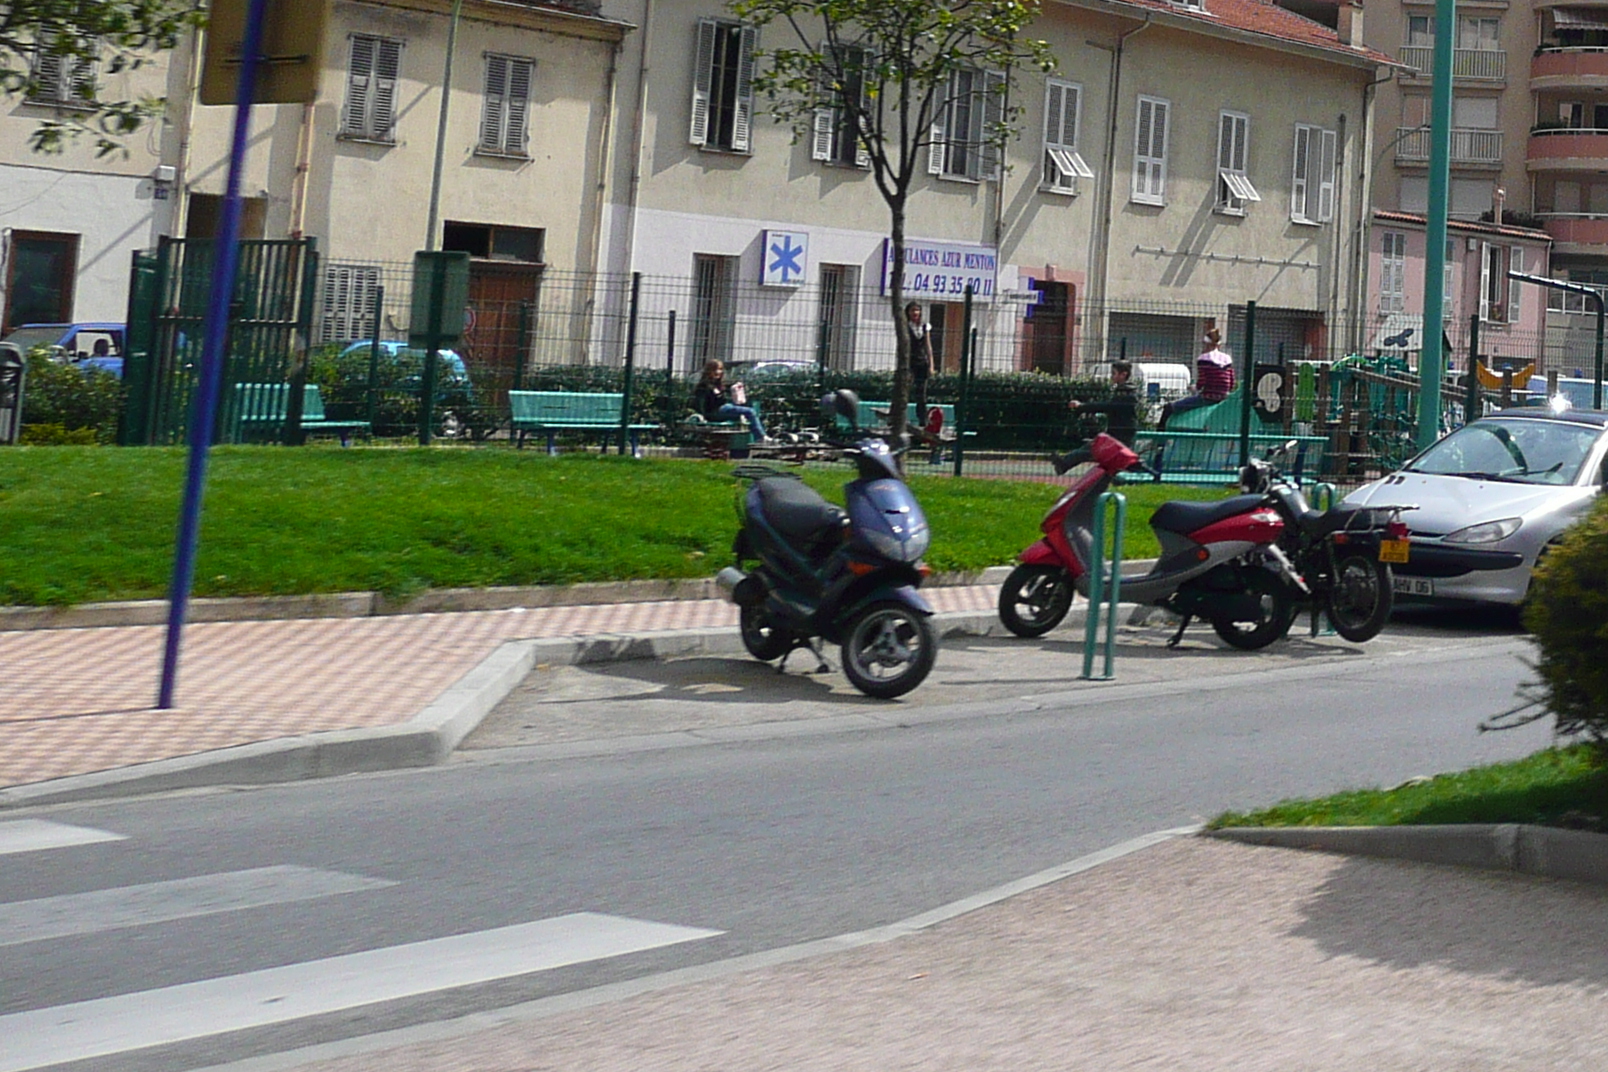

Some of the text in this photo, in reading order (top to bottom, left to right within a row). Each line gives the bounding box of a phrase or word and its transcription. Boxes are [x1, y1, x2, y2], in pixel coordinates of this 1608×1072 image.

[888, 247, 995, 270] AULANCES AZUR MENTON
[914, 273, 930, 291] 04
[933, 275, 947, 293] 93
[949, 276, 963, 294] 35
